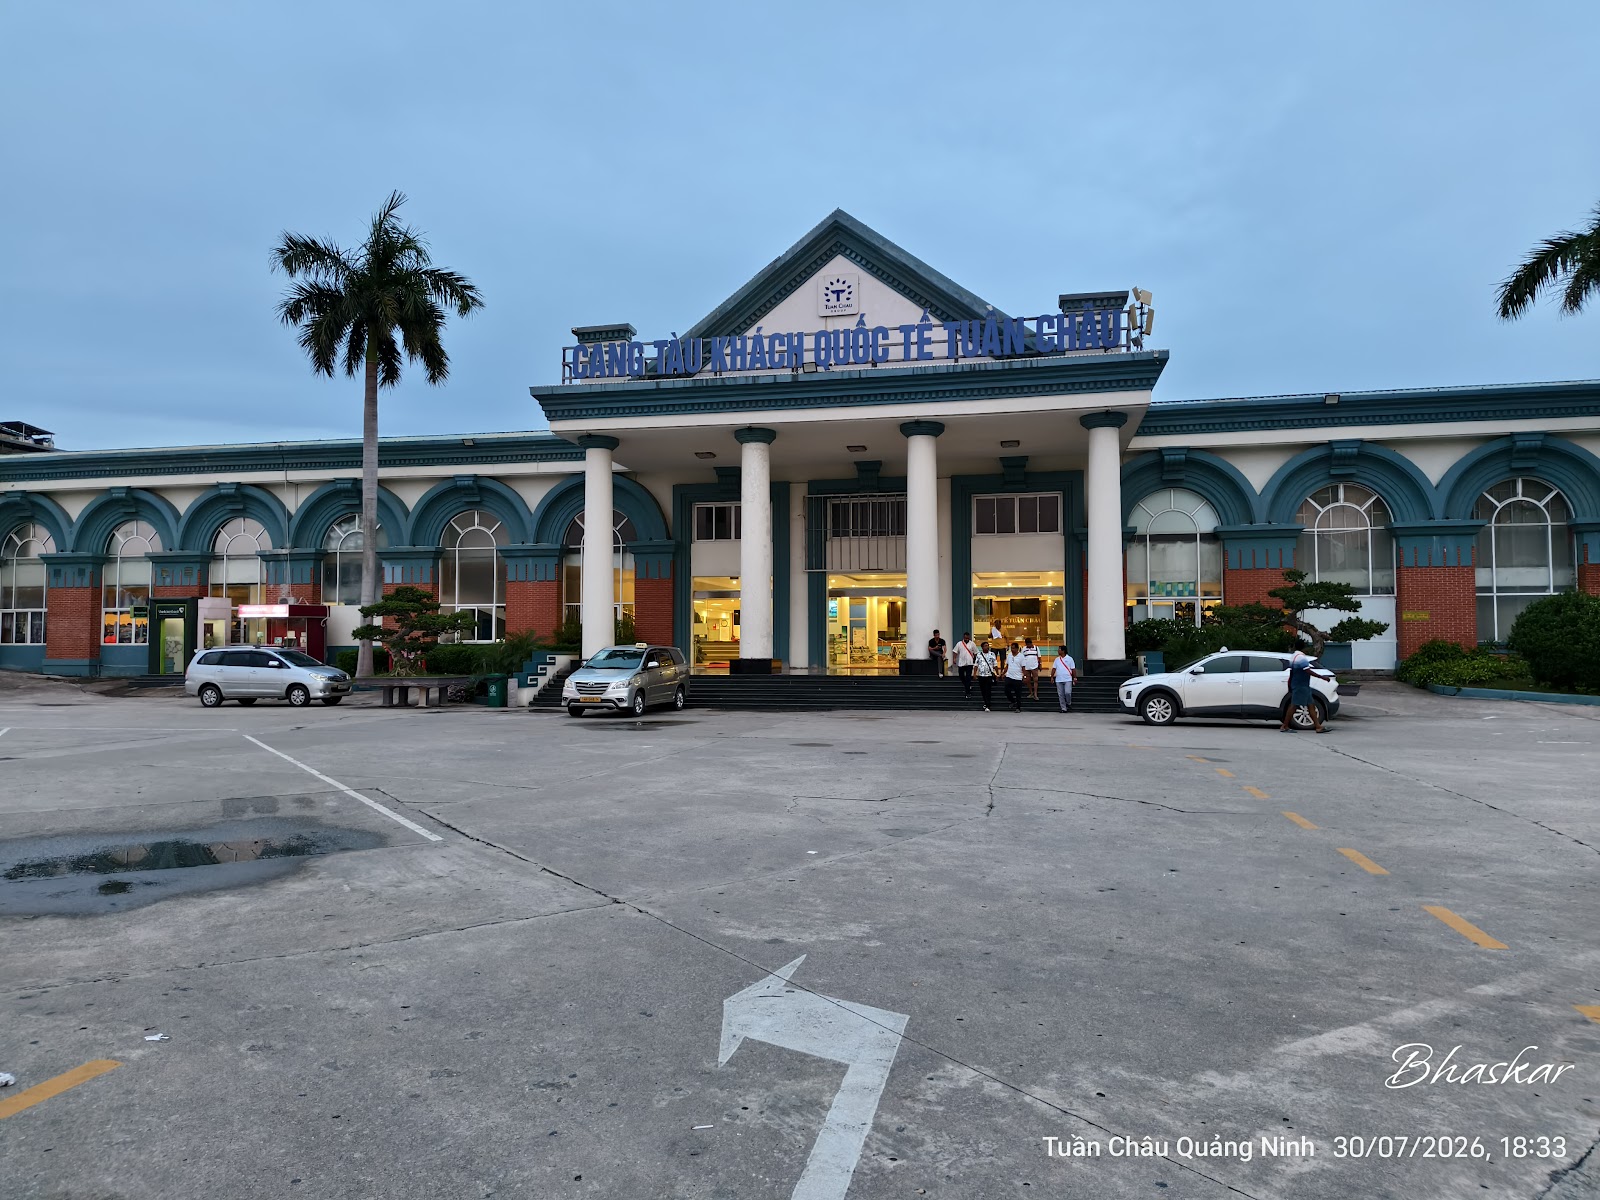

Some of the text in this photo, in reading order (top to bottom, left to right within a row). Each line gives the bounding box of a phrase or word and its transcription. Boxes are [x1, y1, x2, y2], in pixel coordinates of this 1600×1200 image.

[653, 332, 703, 376] TÀU
[711, 326, 804, 374] KHÁCH
[814, 313, 890, 371] QUỐC
[898, 307, 933, 364] TẾ
[1033, 302, 1122, 355] CHÂU
